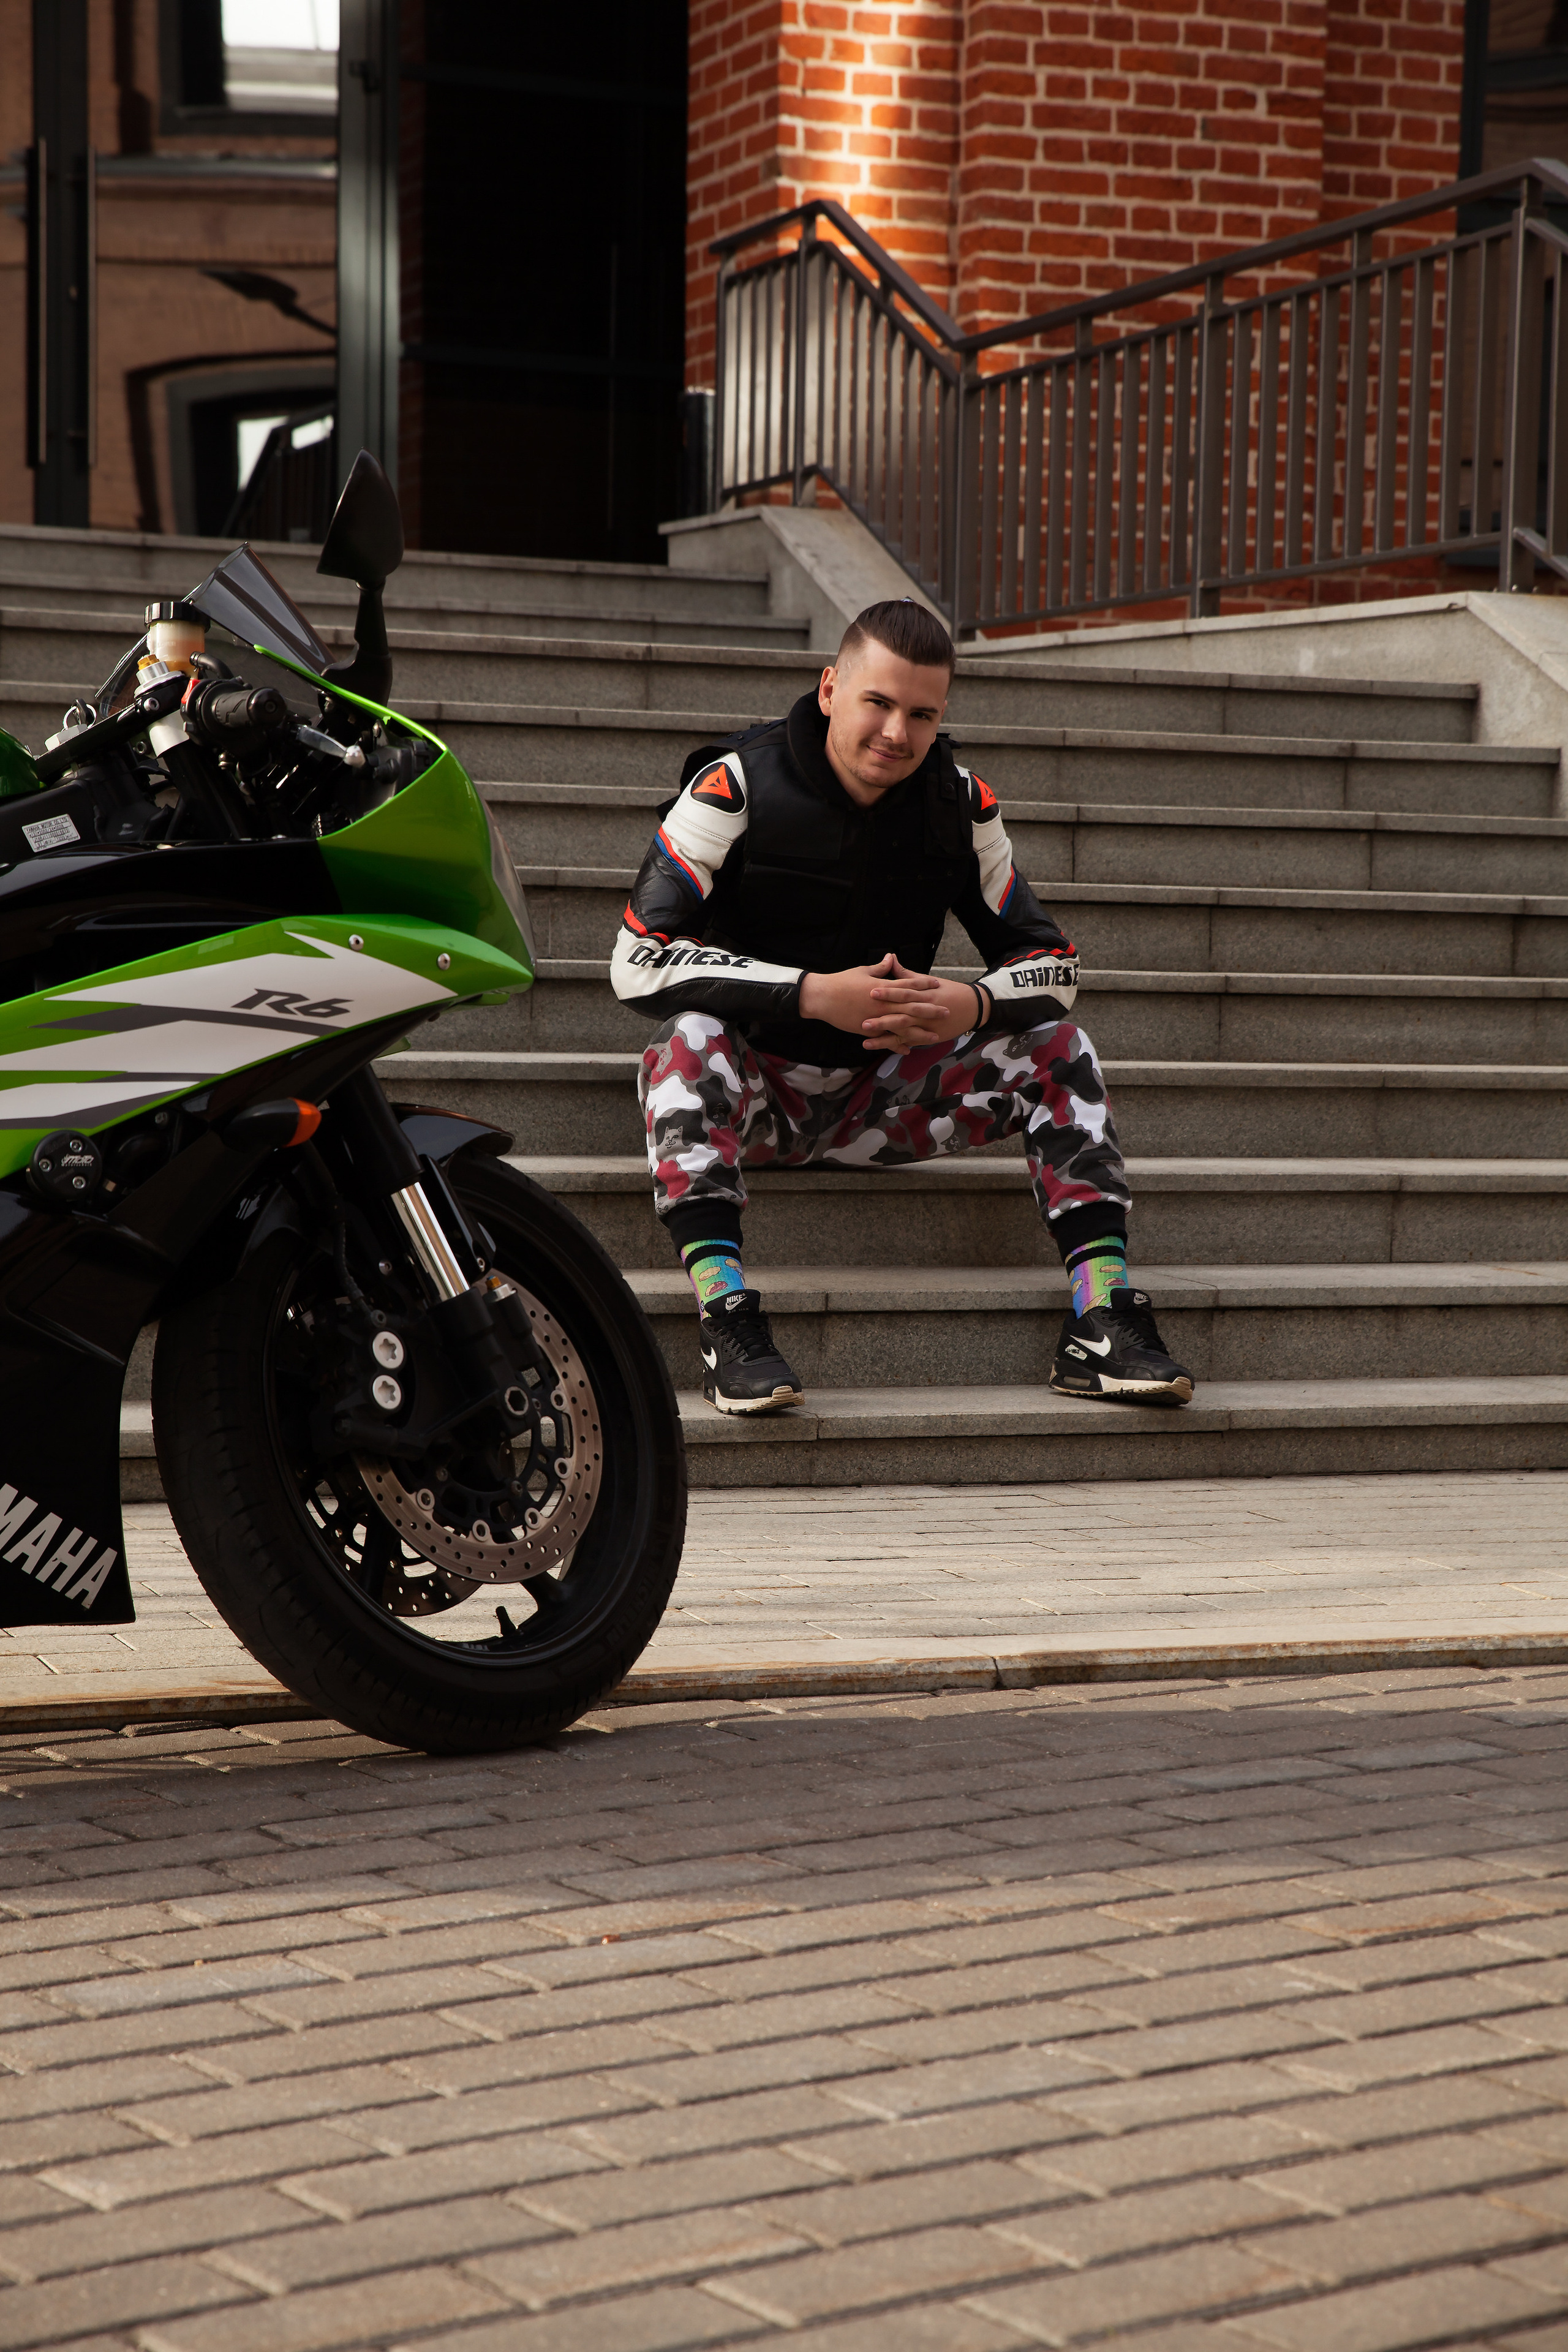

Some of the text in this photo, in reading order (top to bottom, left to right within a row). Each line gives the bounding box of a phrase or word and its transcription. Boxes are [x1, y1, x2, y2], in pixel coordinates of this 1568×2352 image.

[627, 945, 756, 969] DAINESE
[1009, 964, 1080, 987] DAINESE
[230, 988, 355, 1018] R6
[726, 1294, 743, 1303] NIKE
